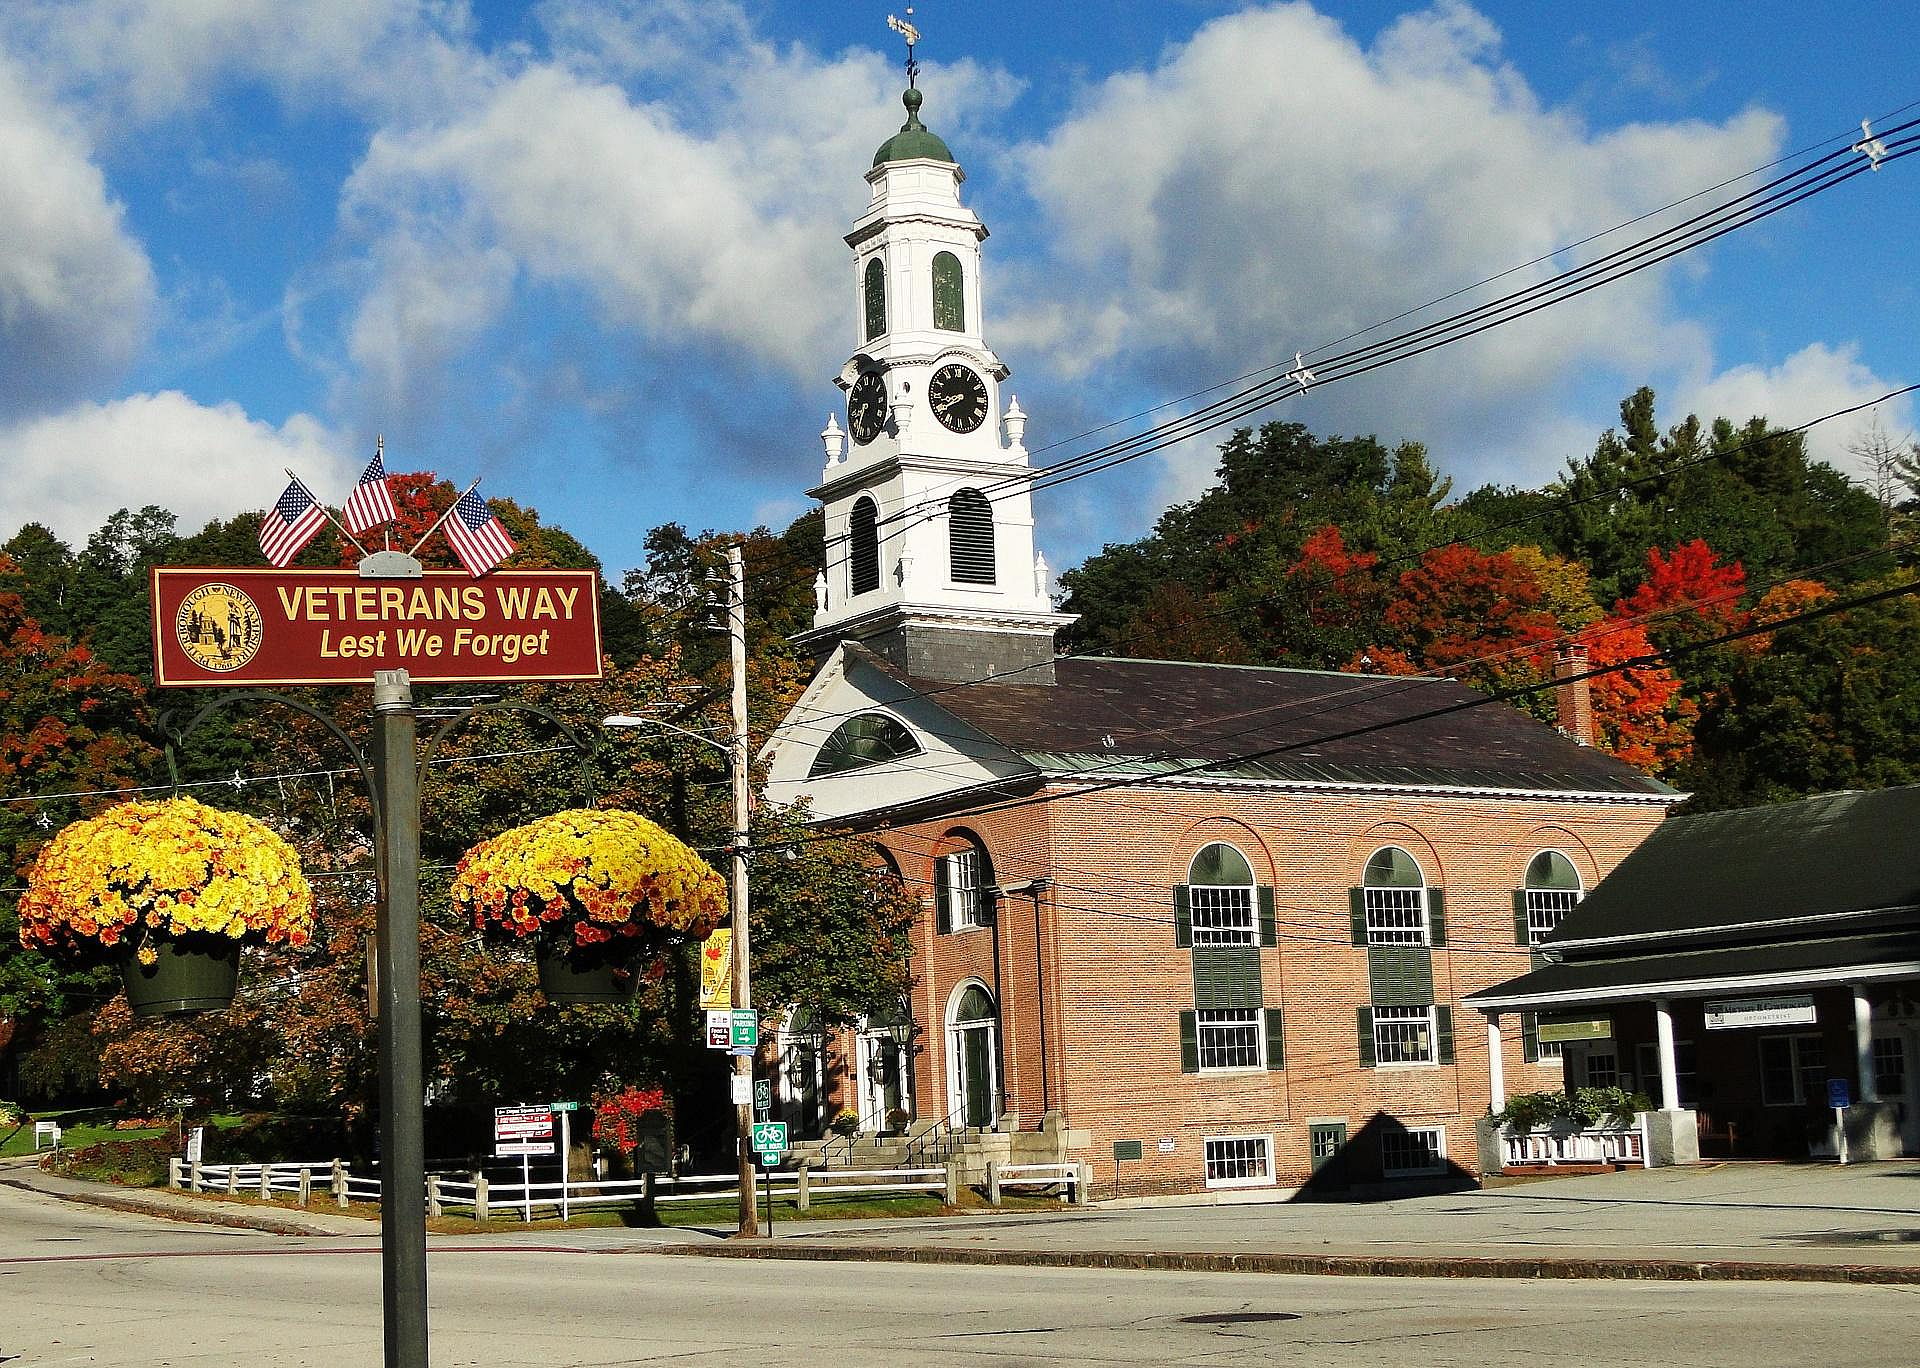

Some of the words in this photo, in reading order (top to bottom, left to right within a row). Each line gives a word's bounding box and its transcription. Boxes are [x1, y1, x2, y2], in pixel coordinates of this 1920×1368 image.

[223, 586, 246, 602] NEW
[277, 586, 486, 621] VETERANS
[496, 586, 579, 620] WAY
[179, 587, 210, 666] PETERBOROUGH
[320, 629, 387, 659] Lest
[396, 629, 443, 658] We
[453, 628, 550, 662] Forget
